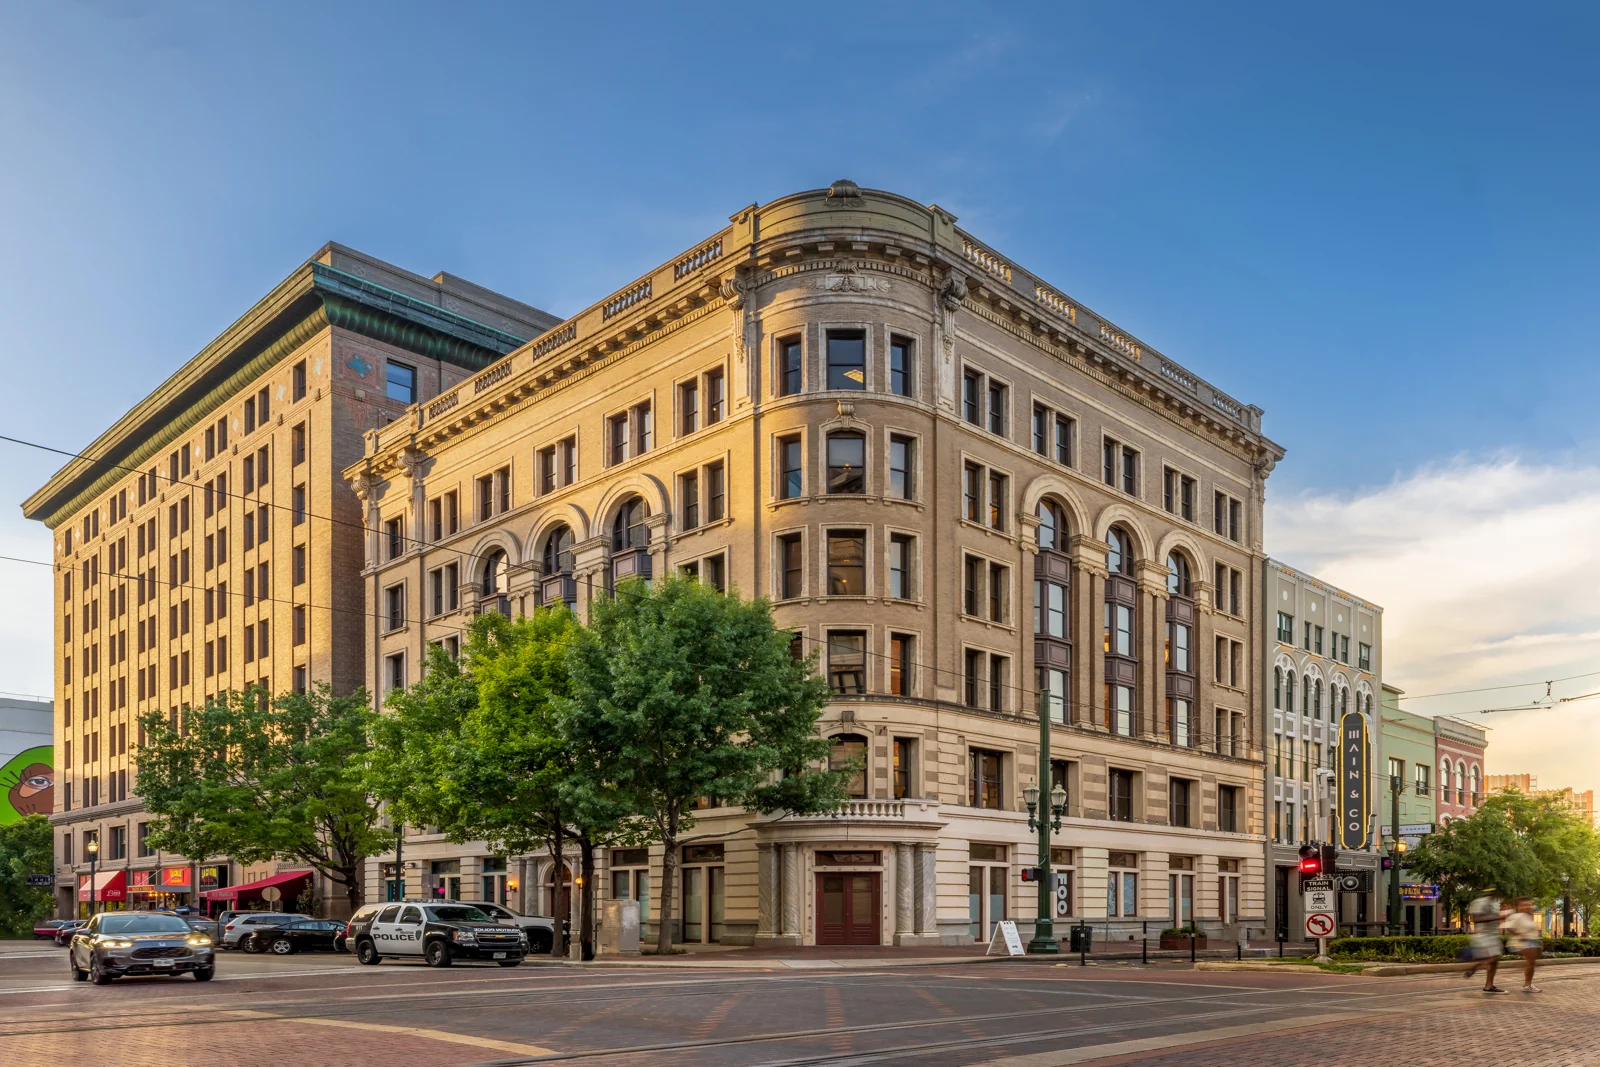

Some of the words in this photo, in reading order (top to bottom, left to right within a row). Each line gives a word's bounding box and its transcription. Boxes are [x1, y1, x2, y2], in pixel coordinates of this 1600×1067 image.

[1350, 789, 1359, 799] &
[1349, 809, 1360, 831] CO
[372, 933, 416, 942] POLICE
